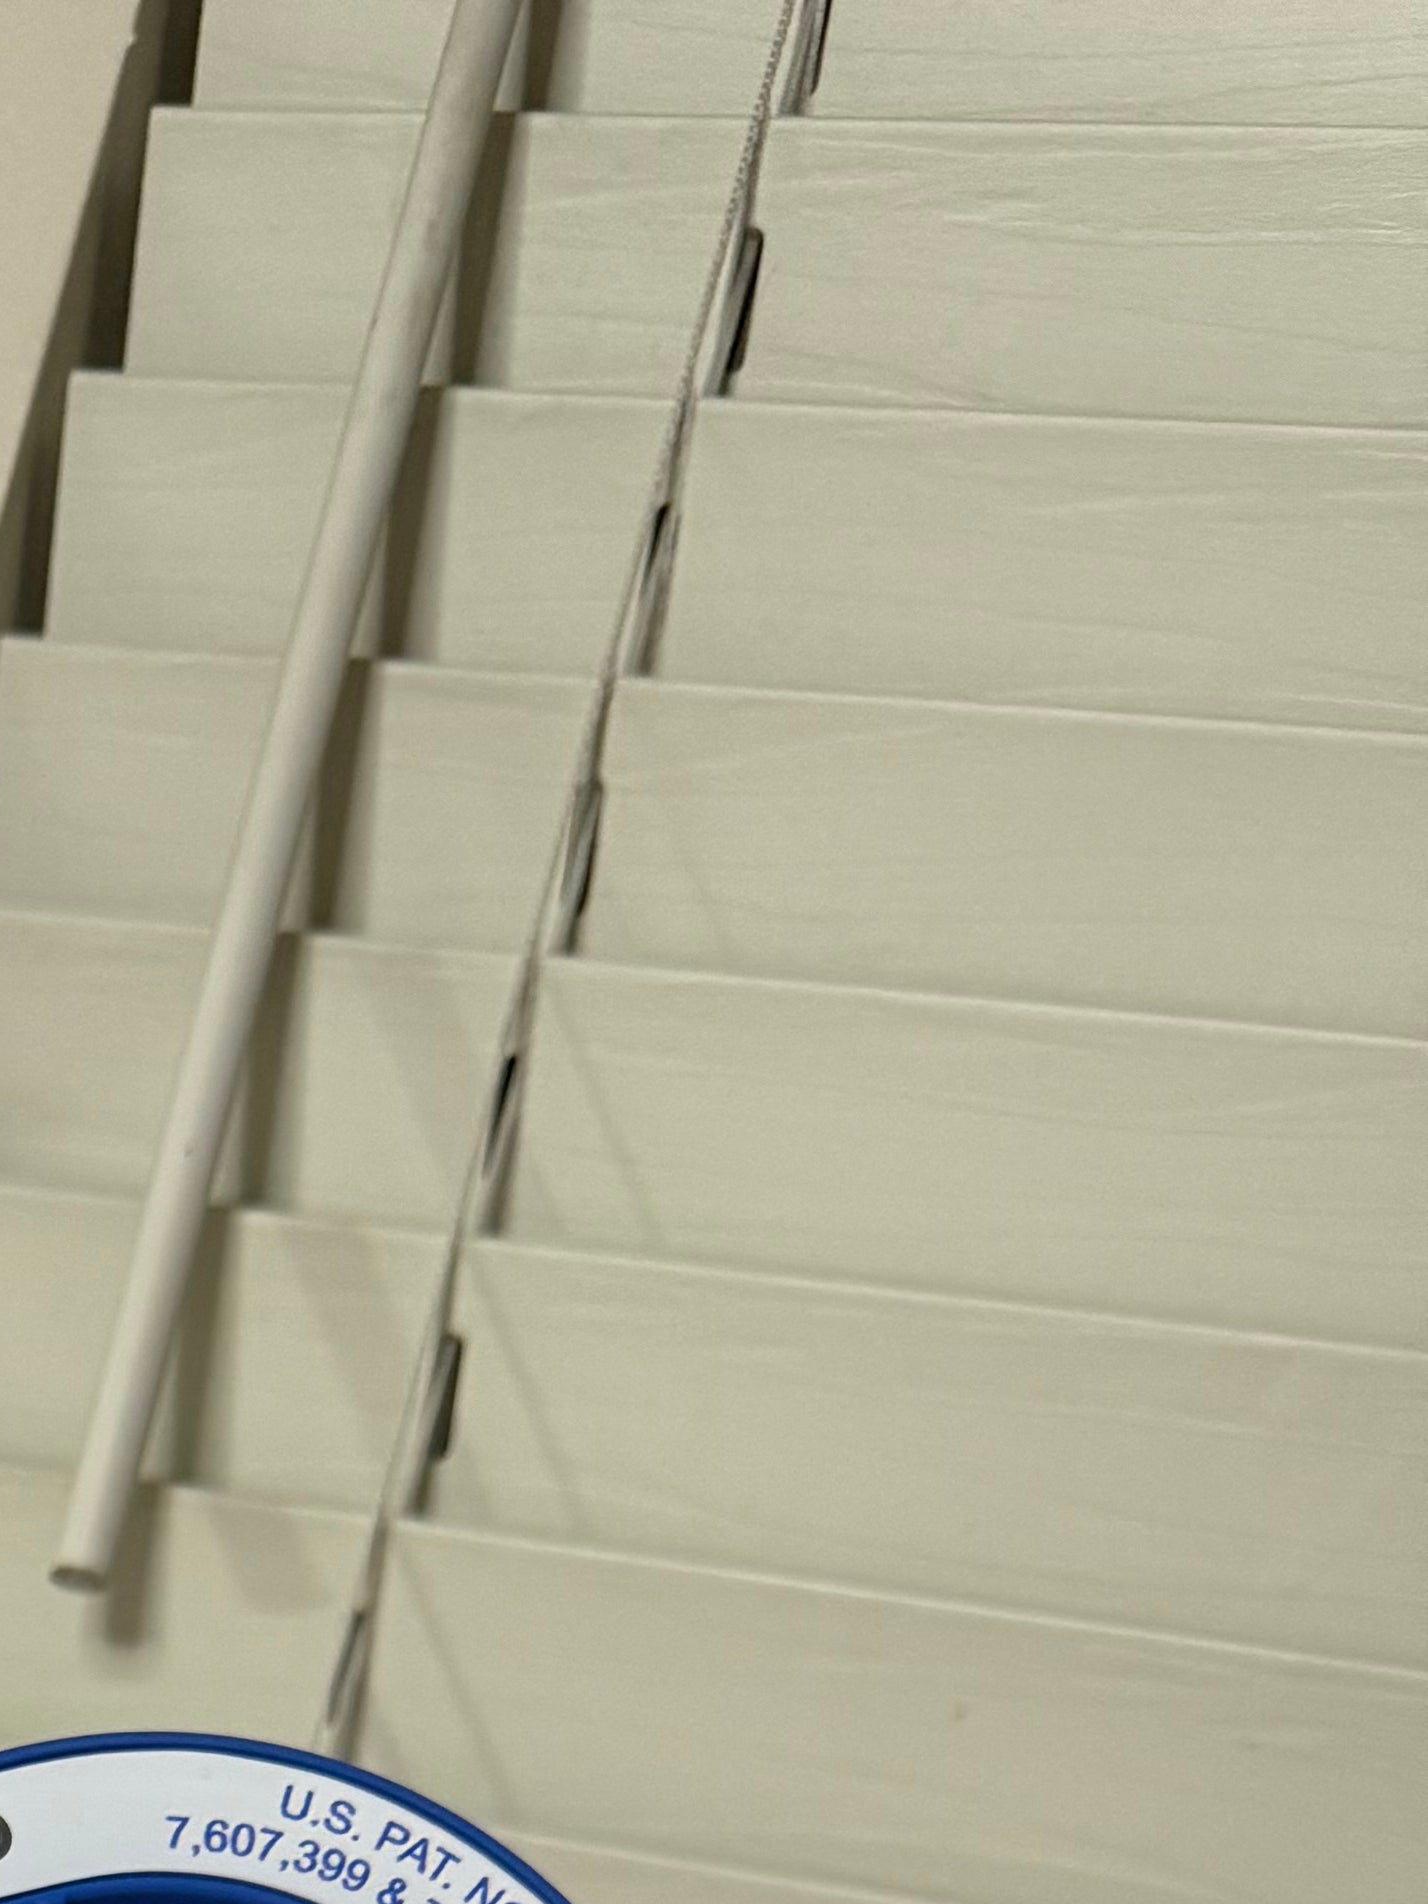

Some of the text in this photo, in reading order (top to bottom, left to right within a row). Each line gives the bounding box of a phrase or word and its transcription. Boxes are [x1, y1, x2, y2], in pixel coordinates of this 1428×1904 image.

[165, 1816, 370, 1894] 7,607,399
[279, 1785, 361, 1843] U.S.
[375, 1821, 461, 1889] PAT.
